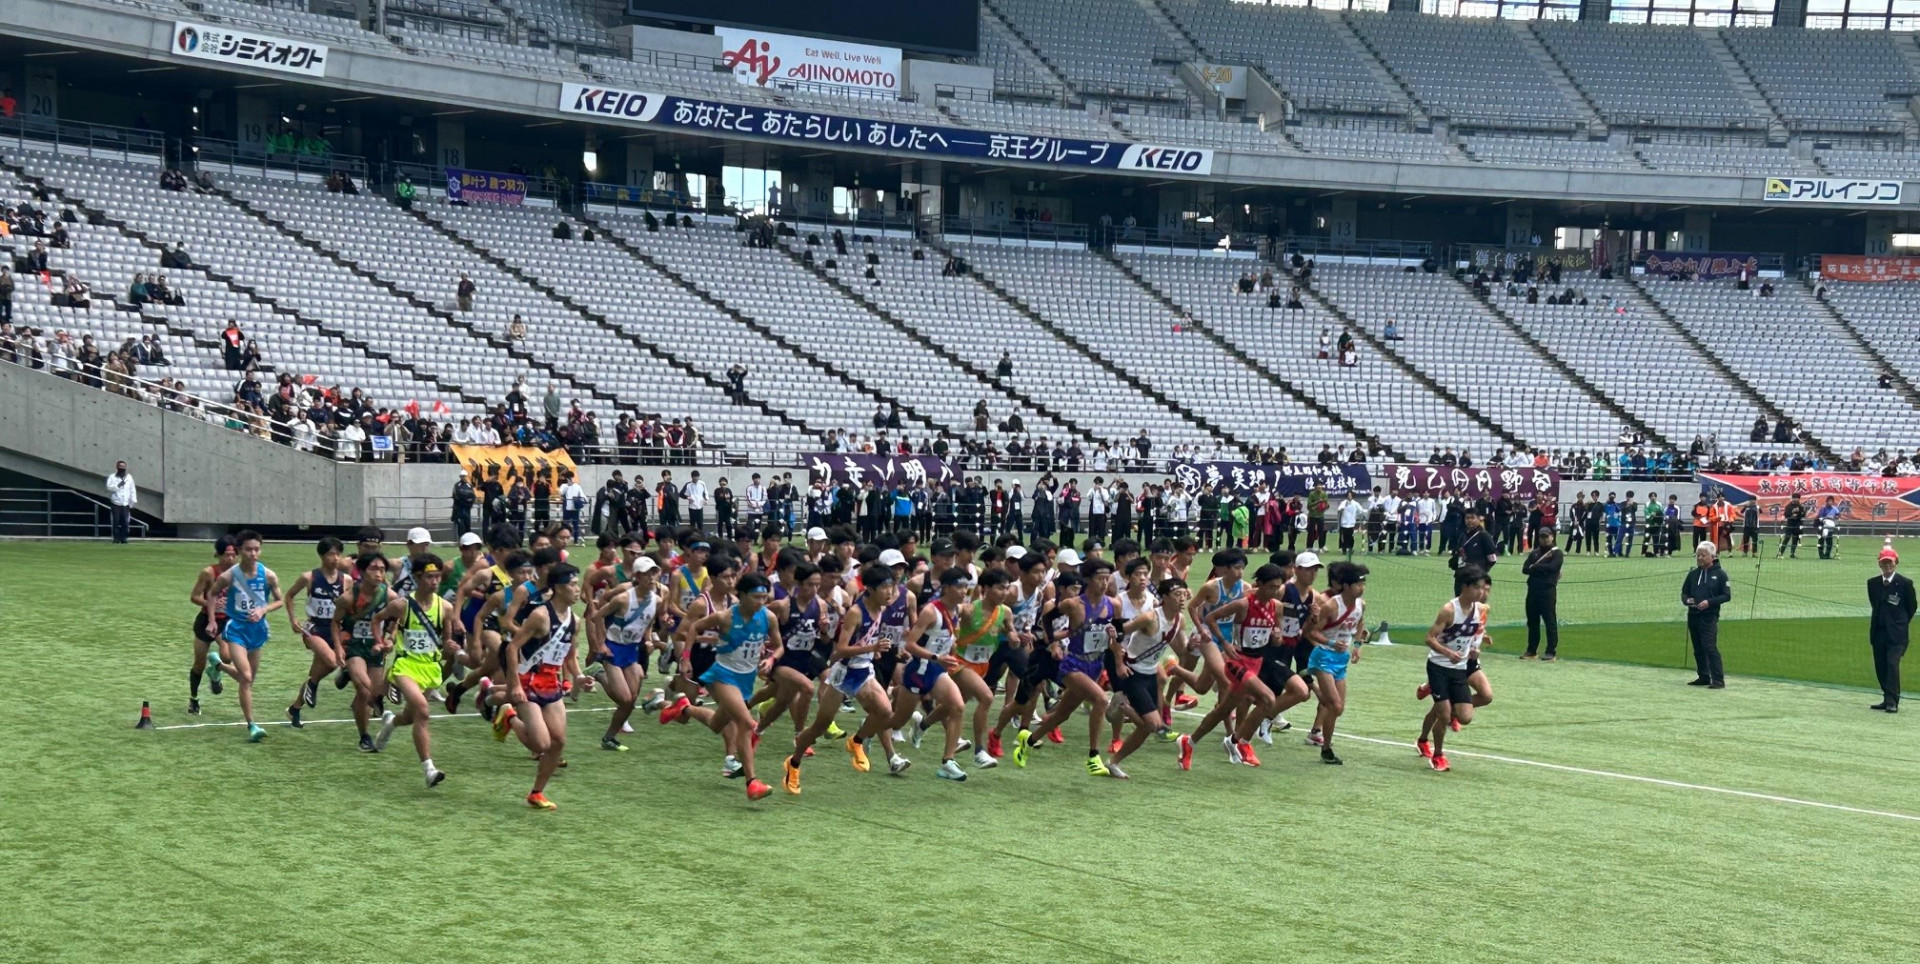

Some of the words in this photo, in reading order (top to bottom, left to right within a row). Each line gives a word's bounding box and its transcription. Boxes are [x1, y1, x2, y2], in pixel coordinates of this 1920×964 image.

[203, 31, 220, 43] 株式
[219, 35, 323, 69] シミズオクト
[805, 48, 818, 57] Eat
[844, 52, 861, 62] Live
[788, 63, 895, 88] AJINOMOTO
[32, 94, 52, 116] 20
[574, 88, 648, 117] KEIO
[244, 124, 261, 142] 19
[673, 101, 754, 132] あなたと
[761, 111, 861, 142] あたらしい
[867, 123, 949, 150] あしたへ
[988, 134, 1109, 164] 京王グループ
[444, 149, 460, 166] 18
[1135, 148, 1203, 171] KEIO
[633, 169, 648, 184] 17
[813, 188, 828, 203] 16
[1792, 181, 1900, 200] アルインコ
[990, 201, 1004, 217] 15
[1164, 212, 1178, 228] 14
[1337, 222, 1351, 237] 13
[1511, 229, 1527, 244] 12
[1872, 239, 1888, 254] 10
[241, 600, 256, 610] 82
